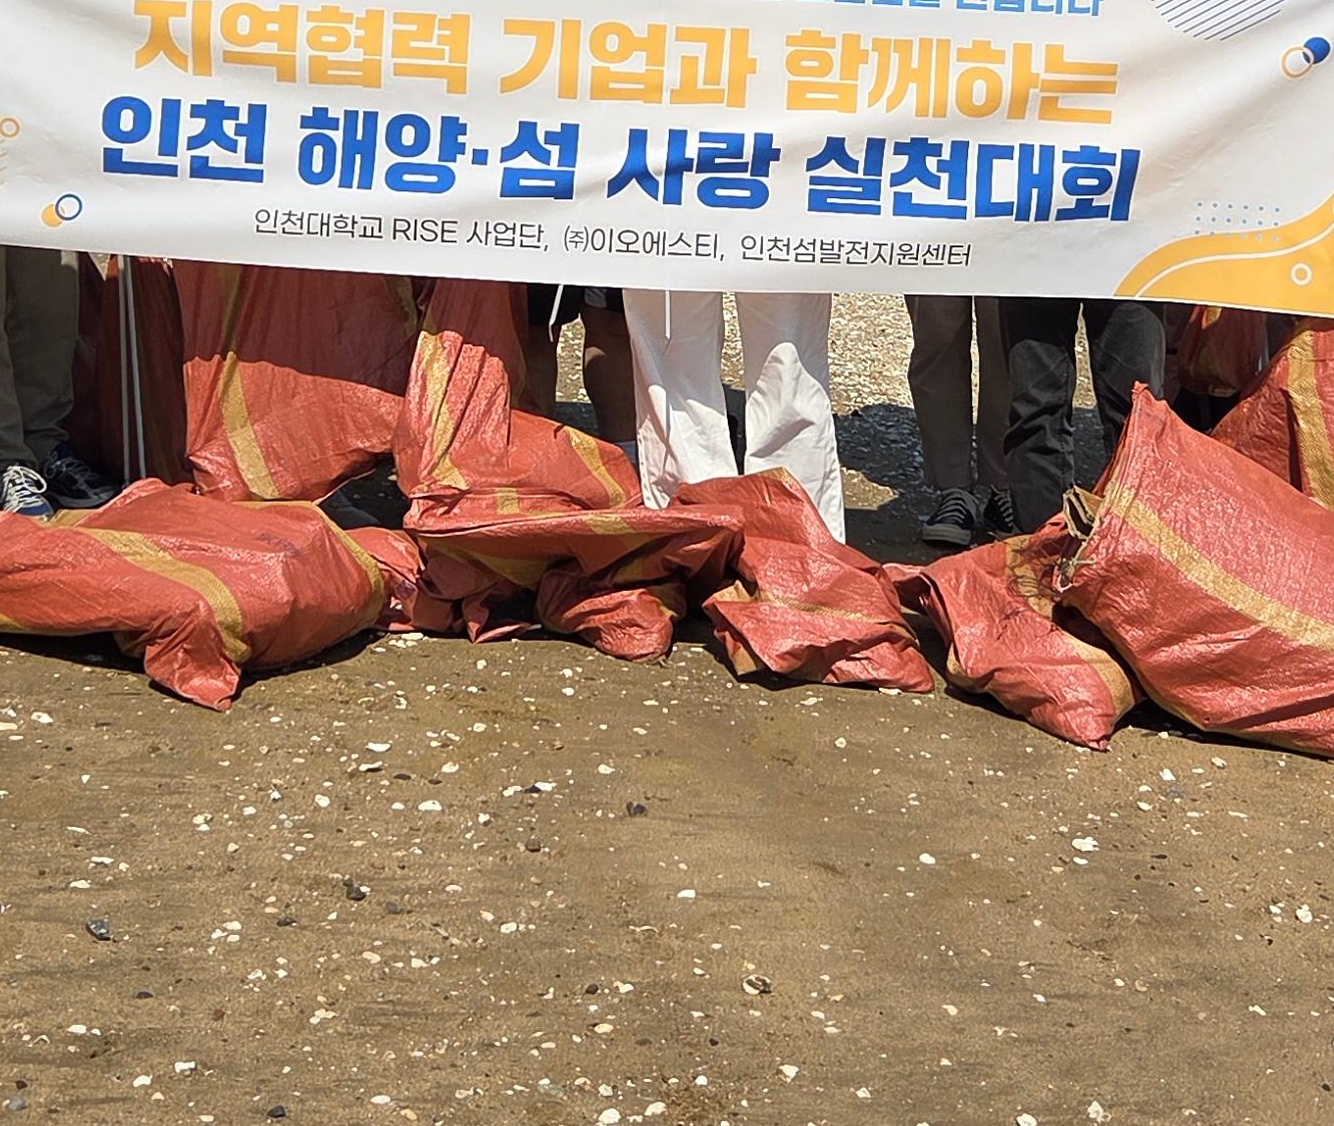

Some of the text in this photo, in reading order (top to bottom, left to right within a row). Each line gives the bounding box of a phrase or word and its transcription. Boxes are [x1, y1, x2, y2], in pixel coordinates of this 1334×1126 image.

[499, 17, 759, 110] 기업과
[784, 28, 1119, 126] 함께하는
[102, 95, 1142, 223] 인천 해양·섬 사랑 실천대회
[254, 209, 384, 240] 인천대학교
[392, 217, 459, 244] RISE
[466, 221, 549, 252] 사업단,
[740, 234, 972, 267] 인천섬발전지원센터
